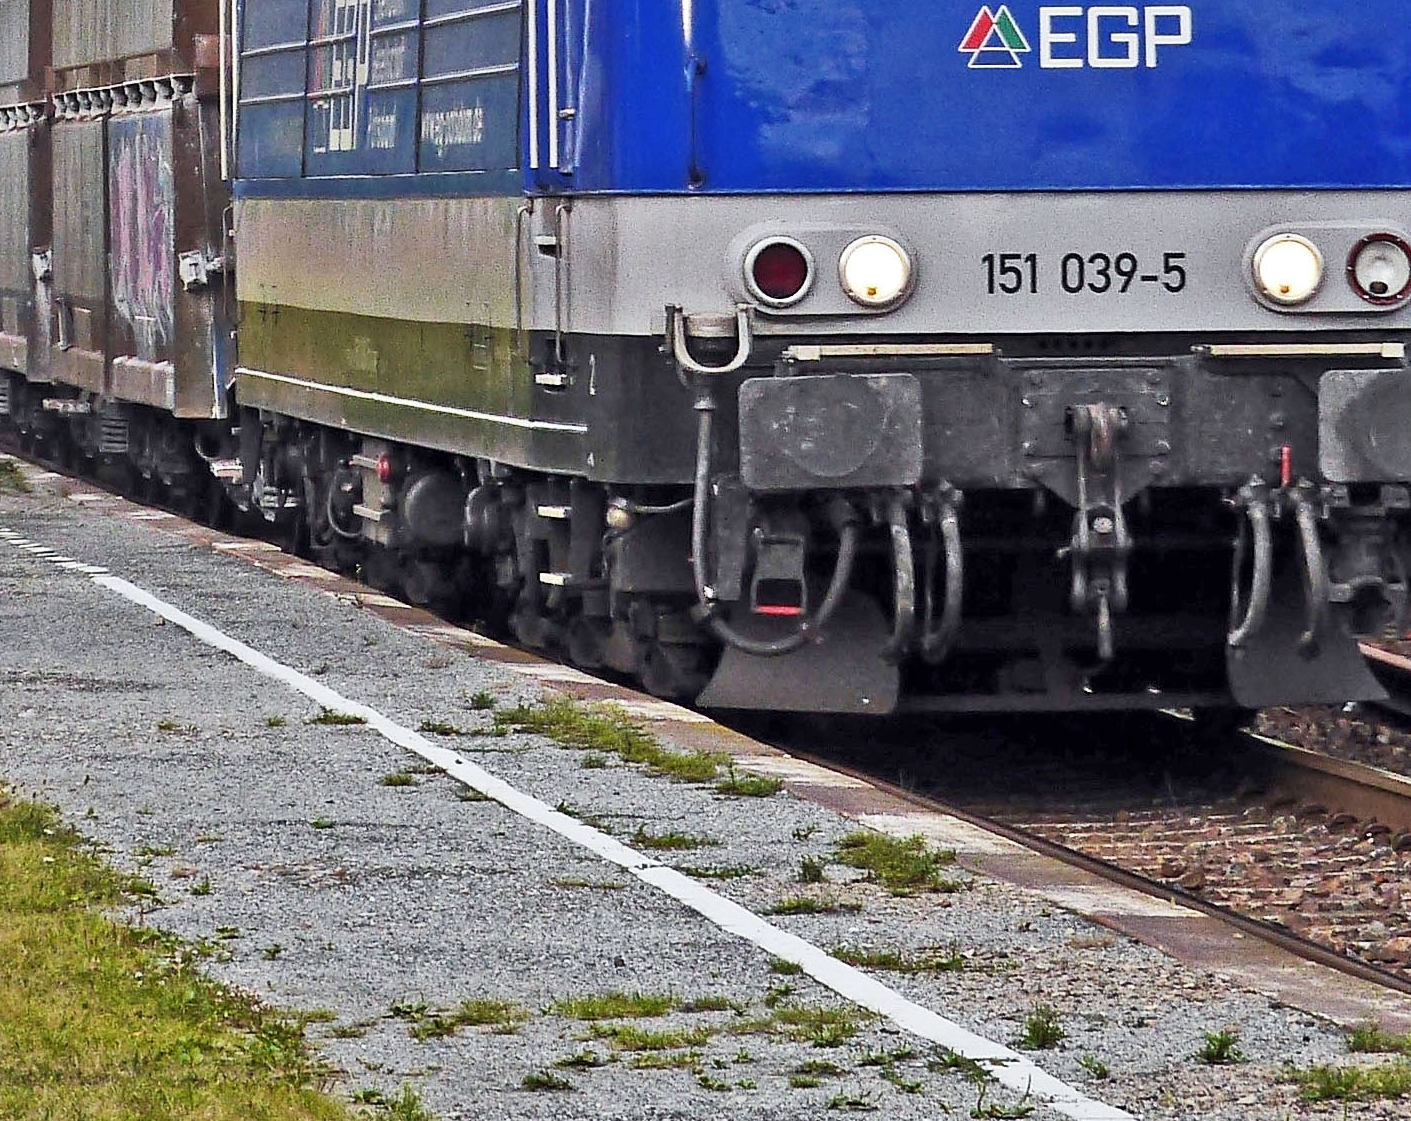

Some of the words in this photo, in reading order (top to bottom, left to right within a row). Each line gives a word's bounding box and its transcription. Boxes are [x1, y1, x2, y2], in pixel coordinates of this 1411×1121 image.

[1039, 6, 1192, 68] EGP
[982, 253, 1038, 294] 151
[1061, 252, 1187, 294] 039-5
